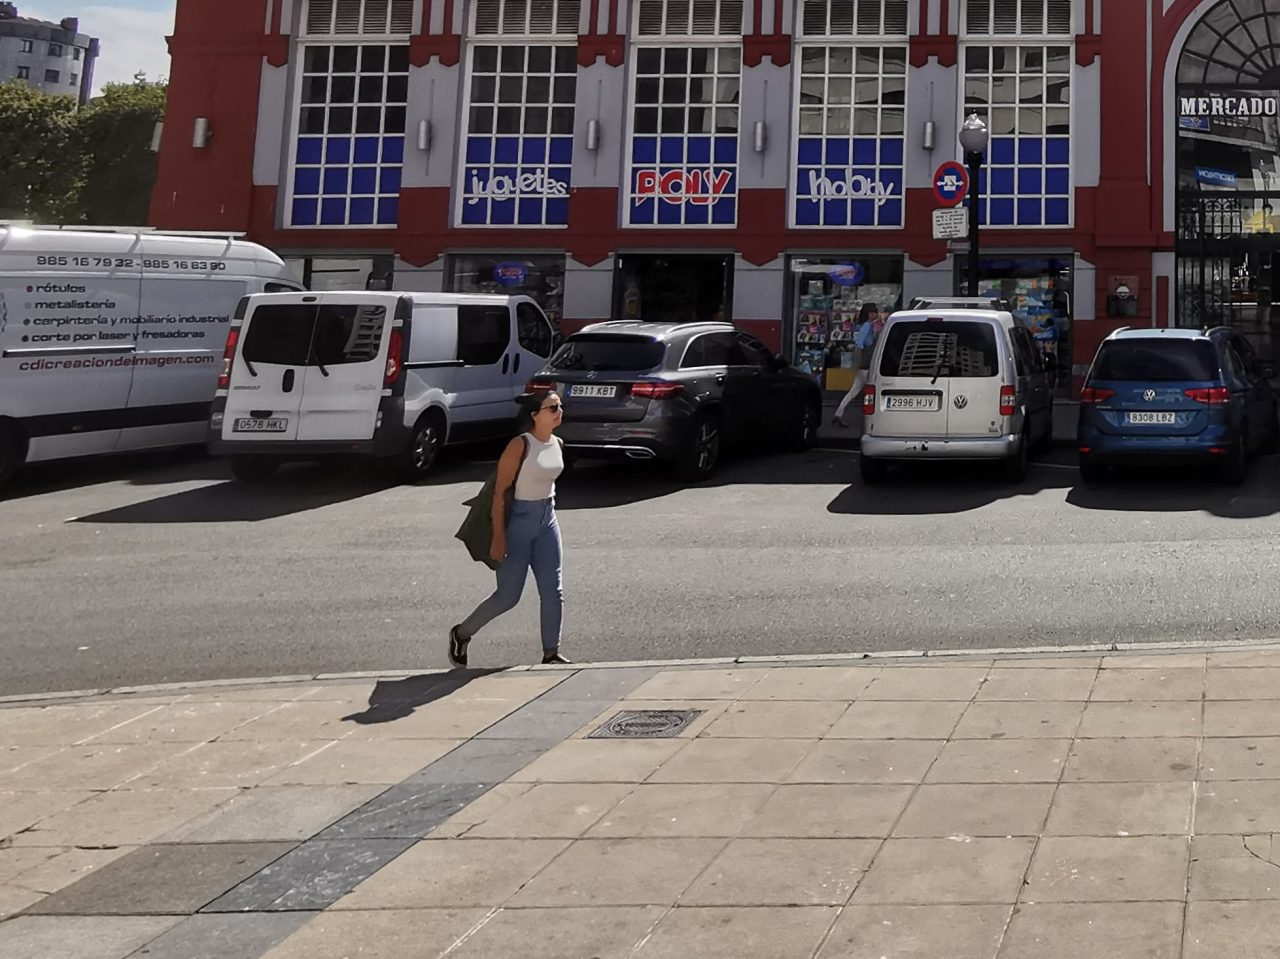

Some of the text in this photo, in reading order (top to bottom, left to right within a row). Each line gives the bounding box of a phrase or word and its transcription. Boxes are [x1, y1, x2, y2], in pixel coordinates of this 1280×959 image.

[1180, 97, 1277, 116] MERCADO
[467, 168, 568, 205] juguetes
[635, 169, 733, 207] POLY
[808, 168, 895, 206] hobby
[36, 256, 68, 266] 985
[72, 257, 89, 267] 16
[93, 257, 113, 268] 79
[174, 260, 188, 269] 16
[191, 260, 208, 270] 83
[209, 261, 226, 271] 90
[36, 283, 86, 293] rótulos
[34, 299, 116, 310] metalistería
[33, 313, 230, 327] carpintería y mobiliario industrial
[32, 332, 71, 342] corte
[73, 332, 96, 343] por
[98, 331, 131, 340] laser
[141, 329, 205, 340] fresadoras
[572, 386, 615, 396] 9911 KBT
[892, 398, 934, 408] 2996 HJV
[239, 420, 285, 430] 0578 HKL
[1131, 413, 1173, 423] 8308 LBZ
